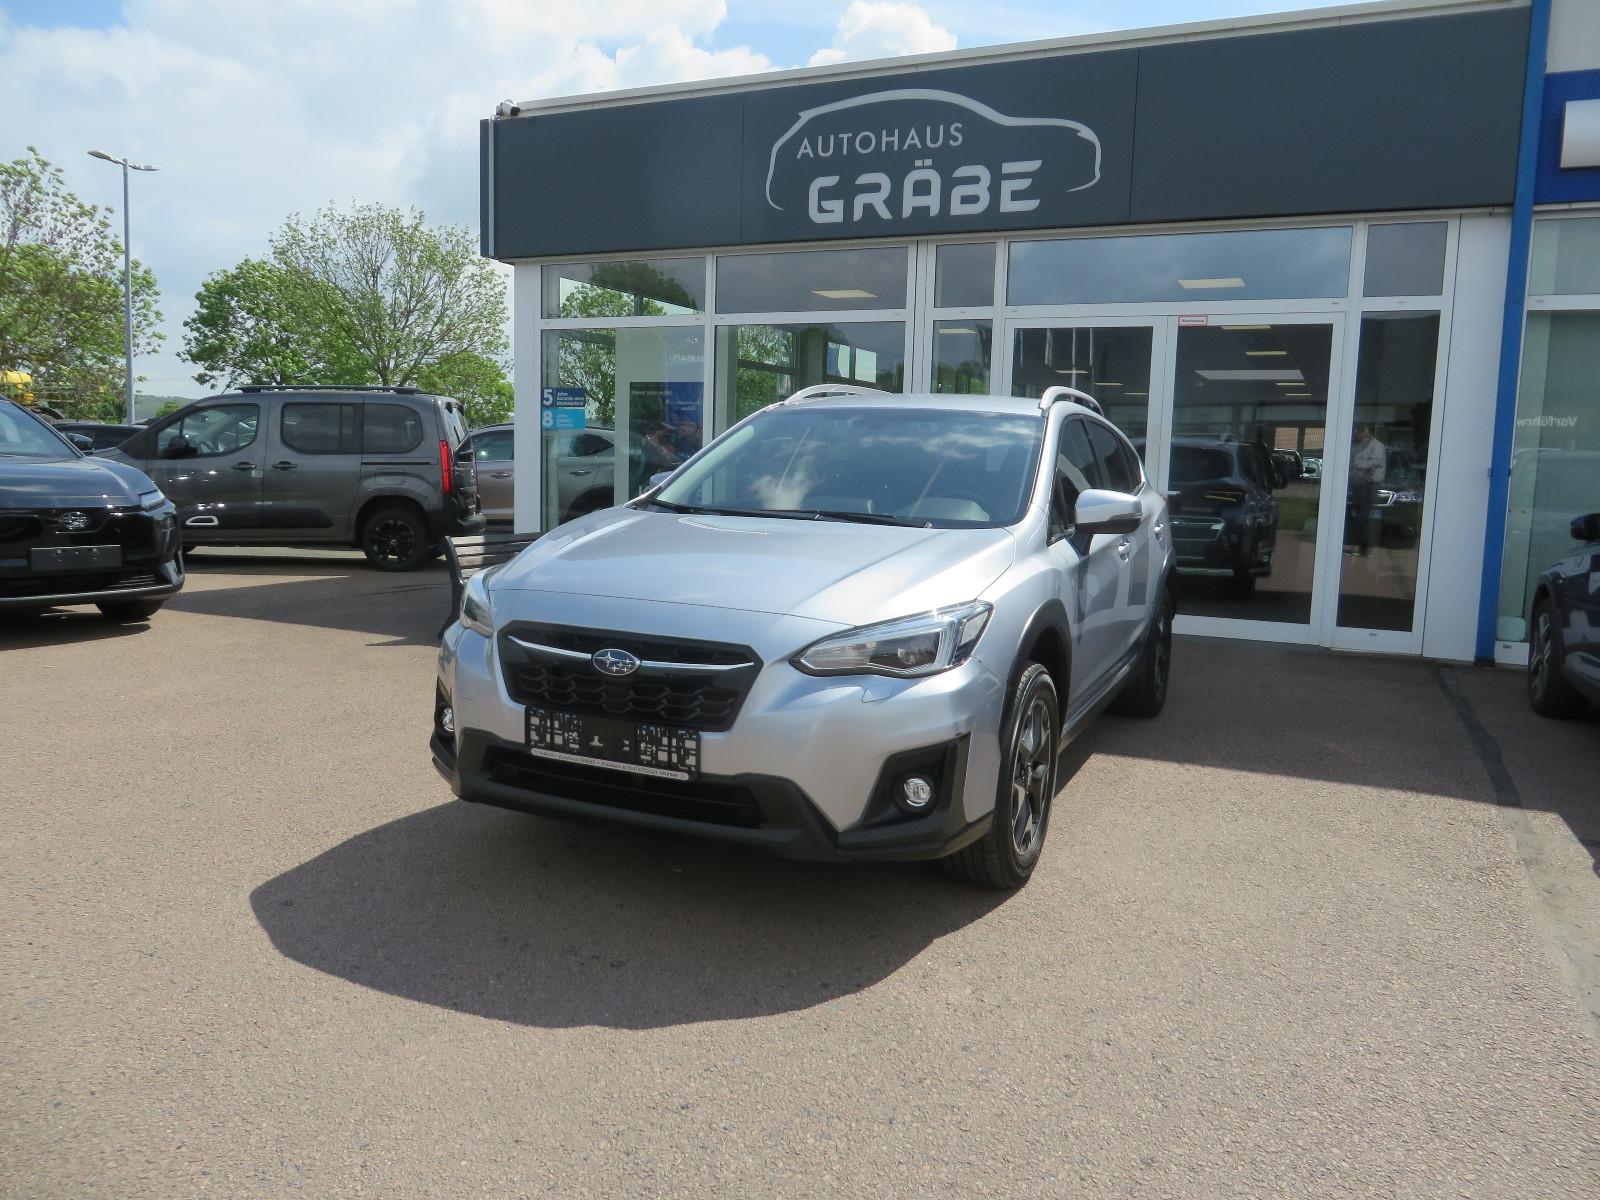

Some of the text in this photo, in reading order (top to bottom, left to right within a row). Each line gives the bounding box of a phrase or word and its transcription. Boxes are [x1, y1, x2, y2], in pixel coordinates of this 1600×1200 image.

[797, 122, 963, 159] AUTOHAUS
[808, 158, 1042, 224] GRÄBE
[543, 388, 553, 406] 5
[543, 411, 553, 427] 8
